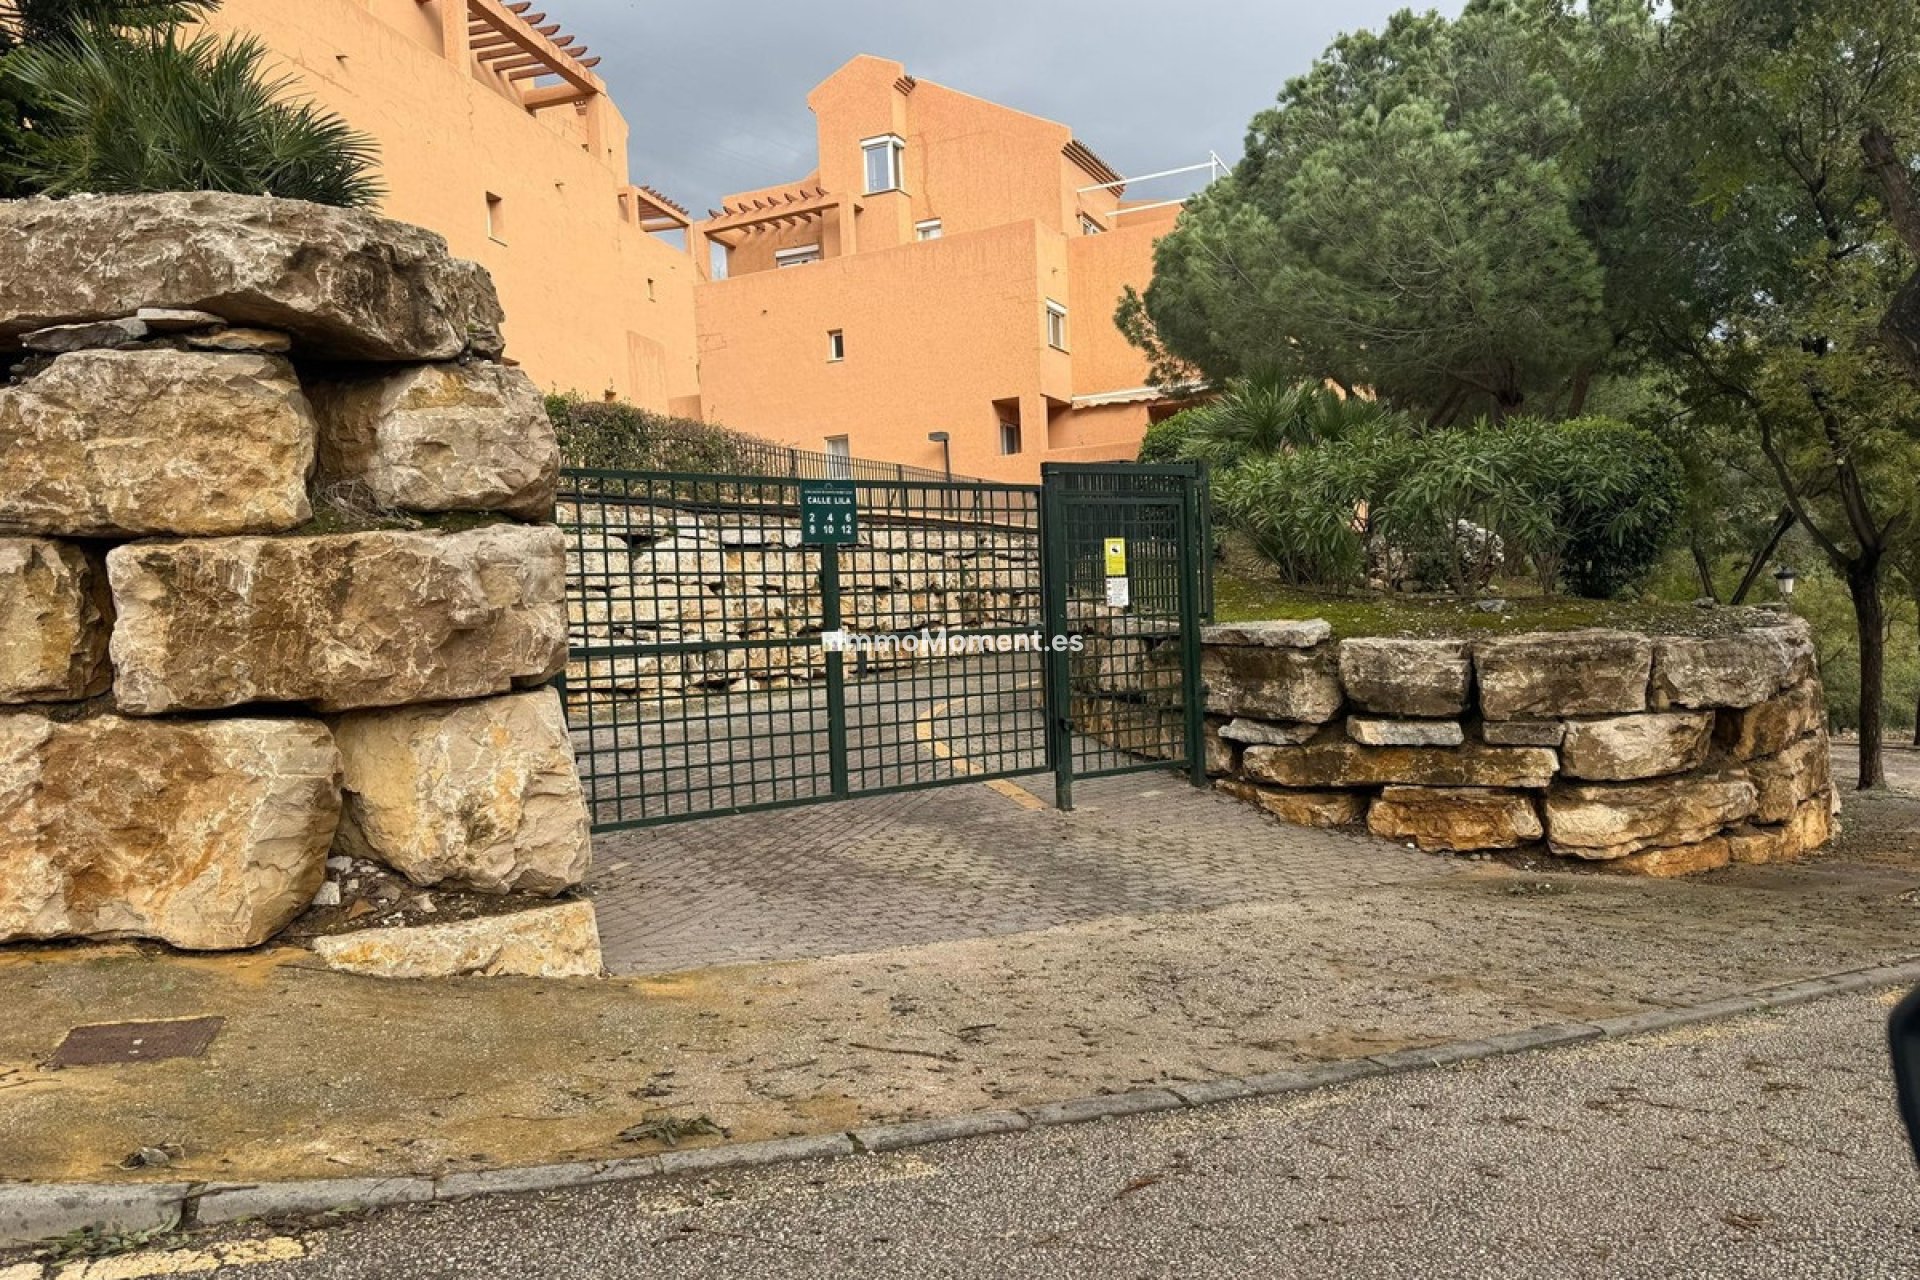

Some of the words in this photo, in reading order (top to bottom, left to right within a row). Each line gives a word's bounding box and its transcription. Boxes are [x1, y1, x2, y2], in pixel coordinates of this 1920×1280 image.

[807, 496, 831, 505] CALLE
[834, 496, 852, 505] LILA
[809, 512, 815, 522] 2
[827, 512, 833, 522] 4
[845, 512, 852, 522] 6
[809, 524, 816, 534] 8
[823, 524, 834, 534] 10
[841, 524, 852, 534] 12
